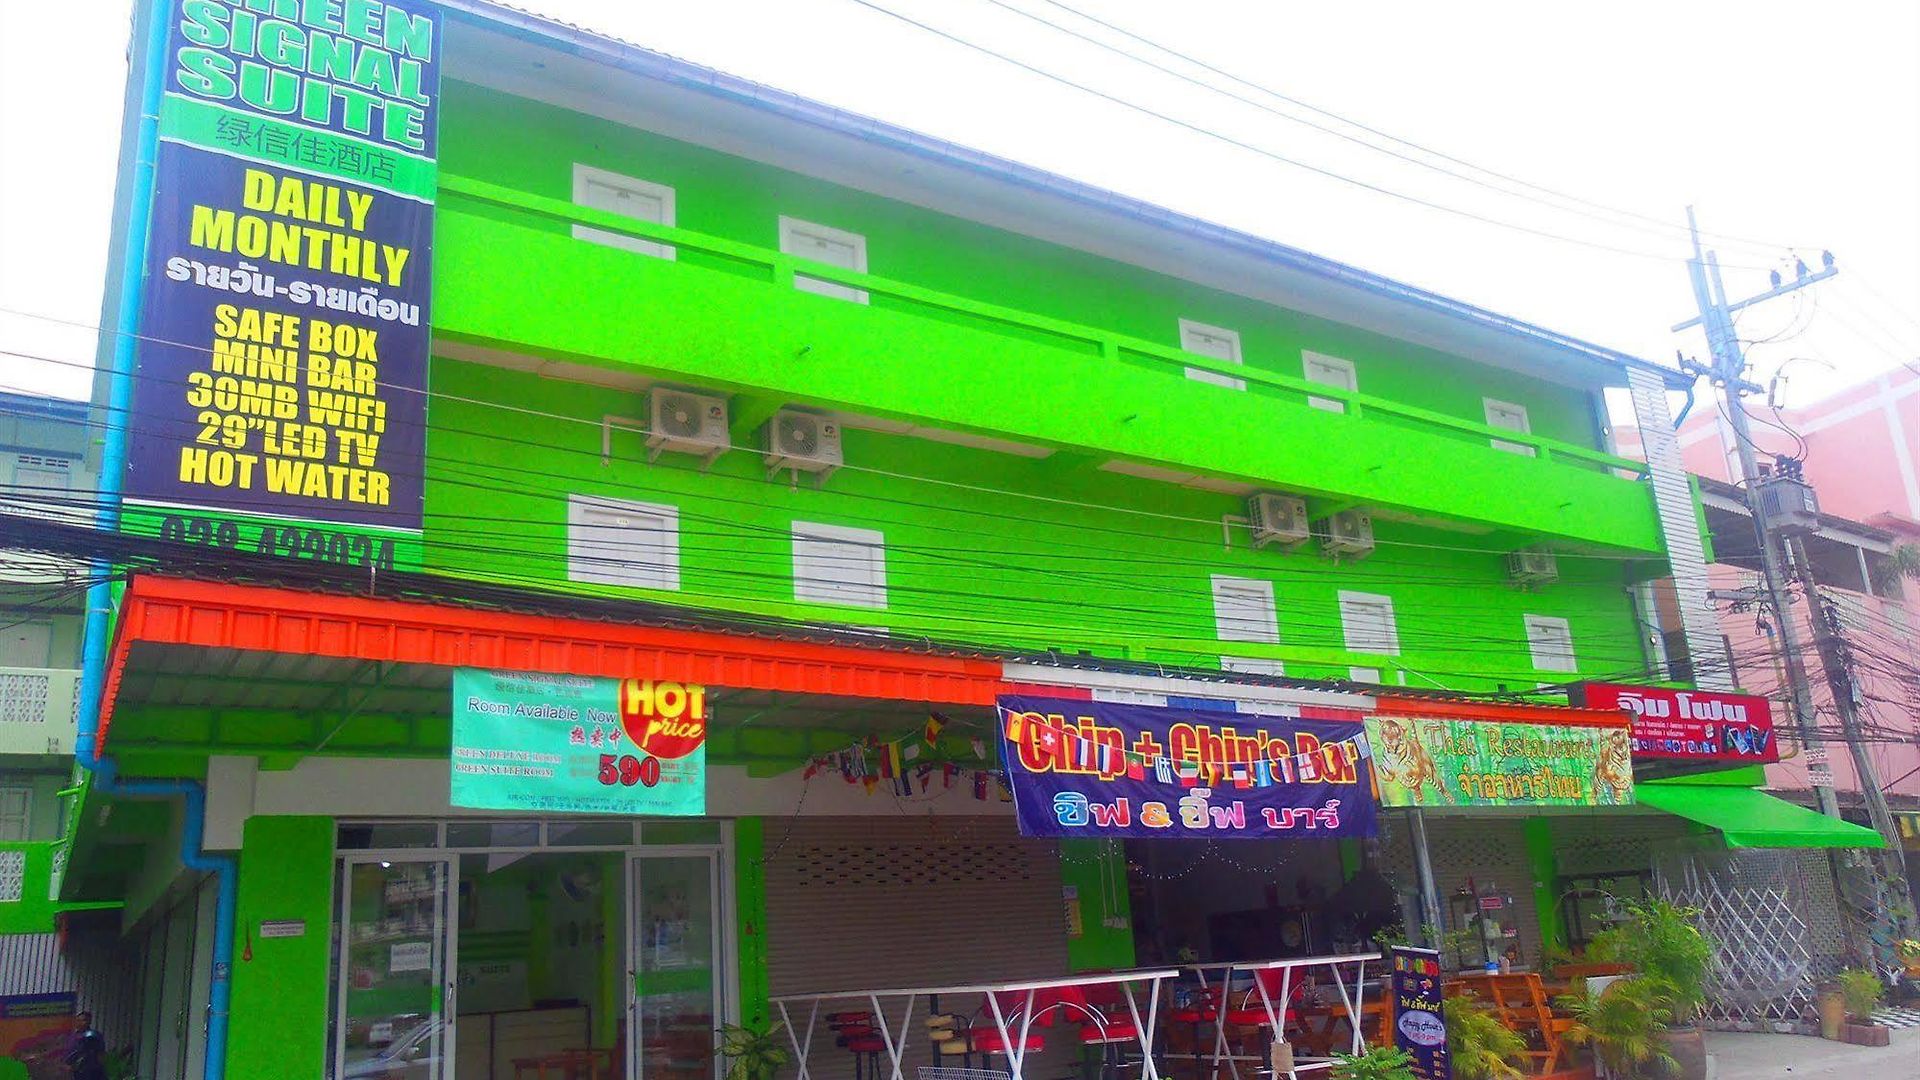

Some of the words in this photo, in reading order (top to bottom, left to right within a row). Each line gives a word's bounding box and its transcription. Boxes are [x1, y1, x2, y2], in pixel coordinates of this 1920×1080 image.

[181, 0, 429, 106] SIGNAL
[216, 0, 432, 63] EEN
[177, 47, 424, 150] SUITE
[215, 114, 396, 183] 绿信佳酒店
[243, 168, 374, 232] DAILY
[190, 204, 410, 287] MONTHLY
[166, 256, 420, 326] รายวัน-รายเดือน
[214, 304, 300, 349] SAFE
[309, 319, 378, 363] BOX
[212, 339, 299, 384] MINI
[307, 354, 377, 396] BAR
[187, 372, 298, 420] 30MB
[308, 390, 386, 434] WIFI
[178, 447, 258, 490] HOT
[266, 458, 390, 506] WATER
[335, 430, 379, 467] TV
[468, 697, 510, 715] Room
[515, 703, 578, 721] Available
[587, 708, 616, 723] Now
[627, 680, 704, 719] HOT
[642, 718, 703, 748] price
[1017, 711, 1126, 781] Chip
[1133, 731, 1162, 767] +
[598, 753, 660, 788] 590
[1140, 801, 1174, 828] &
[1261, 800, 1341, 829] บาร์
